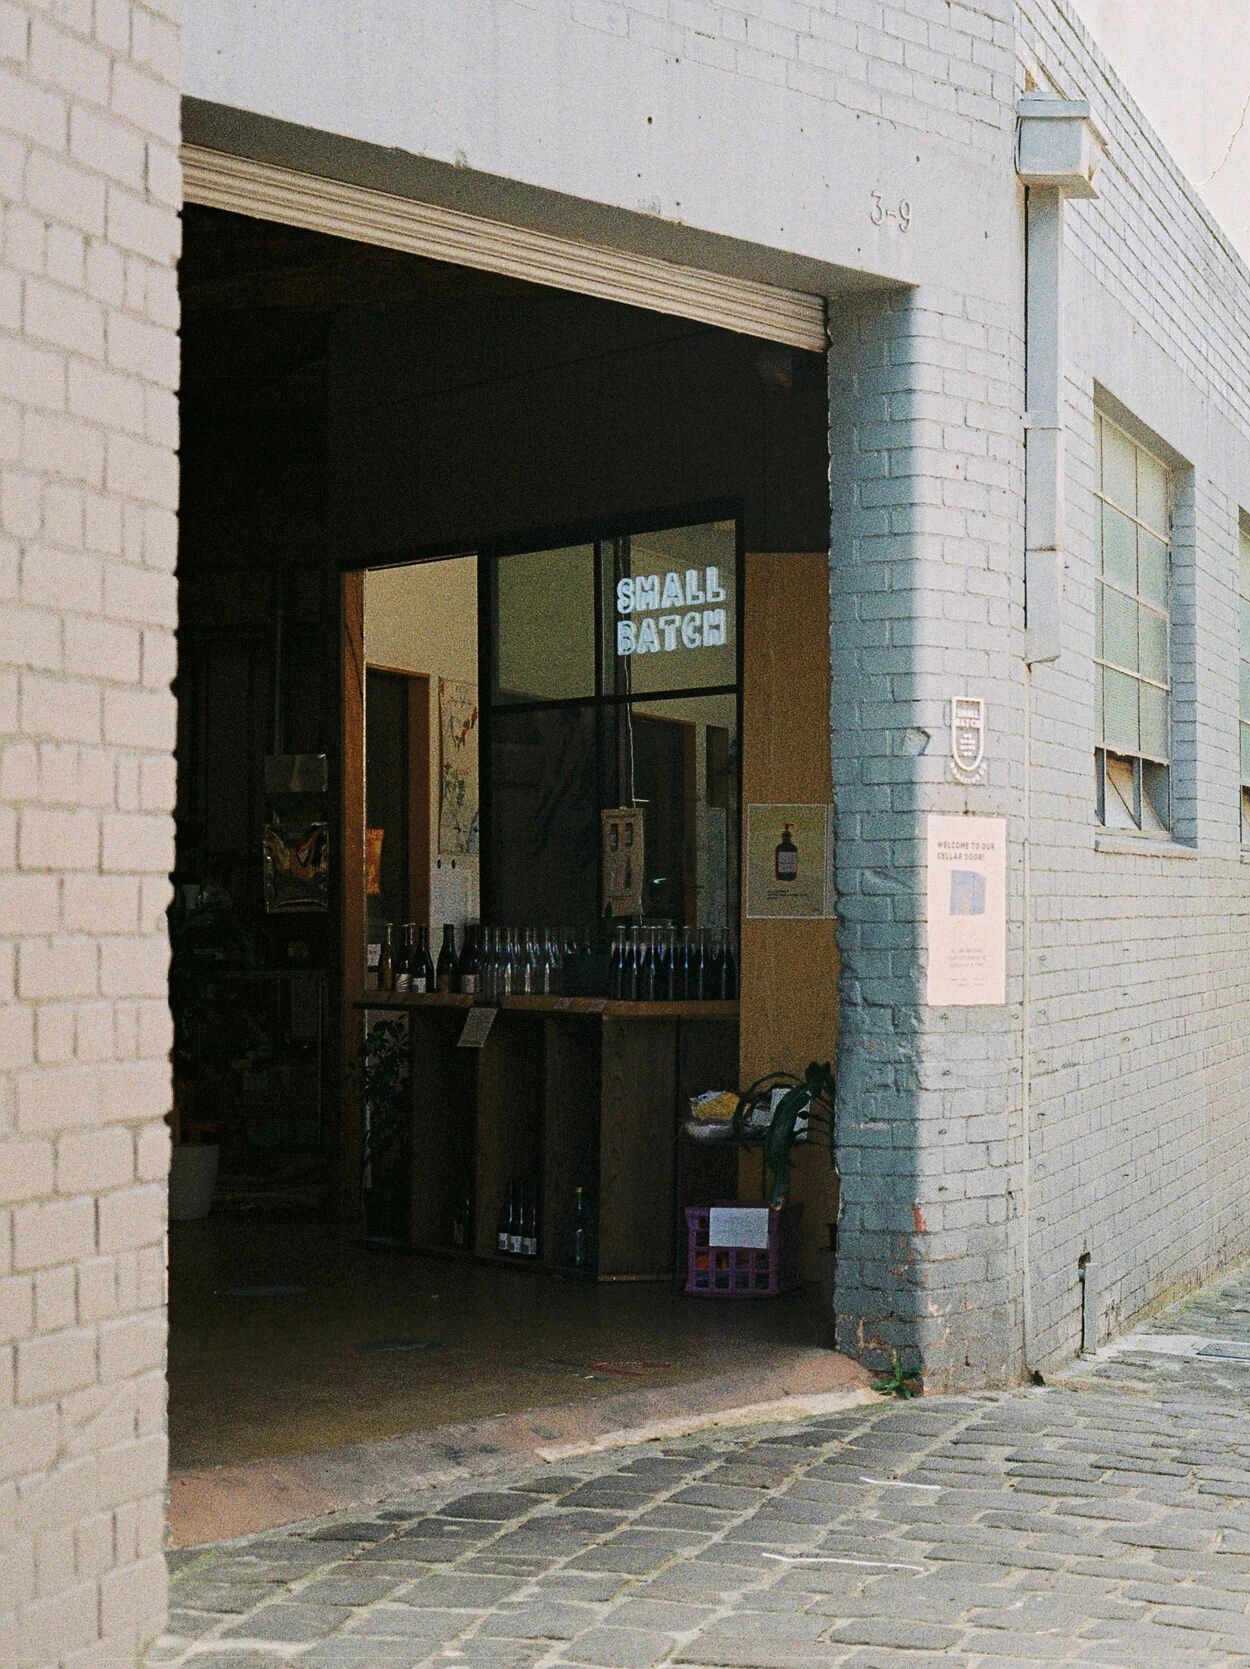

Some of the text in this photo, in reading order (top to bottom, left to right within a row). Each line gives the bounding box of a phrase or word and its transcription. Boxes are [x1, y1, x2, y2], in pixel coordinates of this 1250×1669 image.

[870, 189, 911, 233] 3-9
[617, 566, 726, 614] SMALL
[617, 609, 727, 656] BATCH
[937, 841, 995, 851] WELCOME TO OUR
[937, 852, 963, 861] CELLAR
